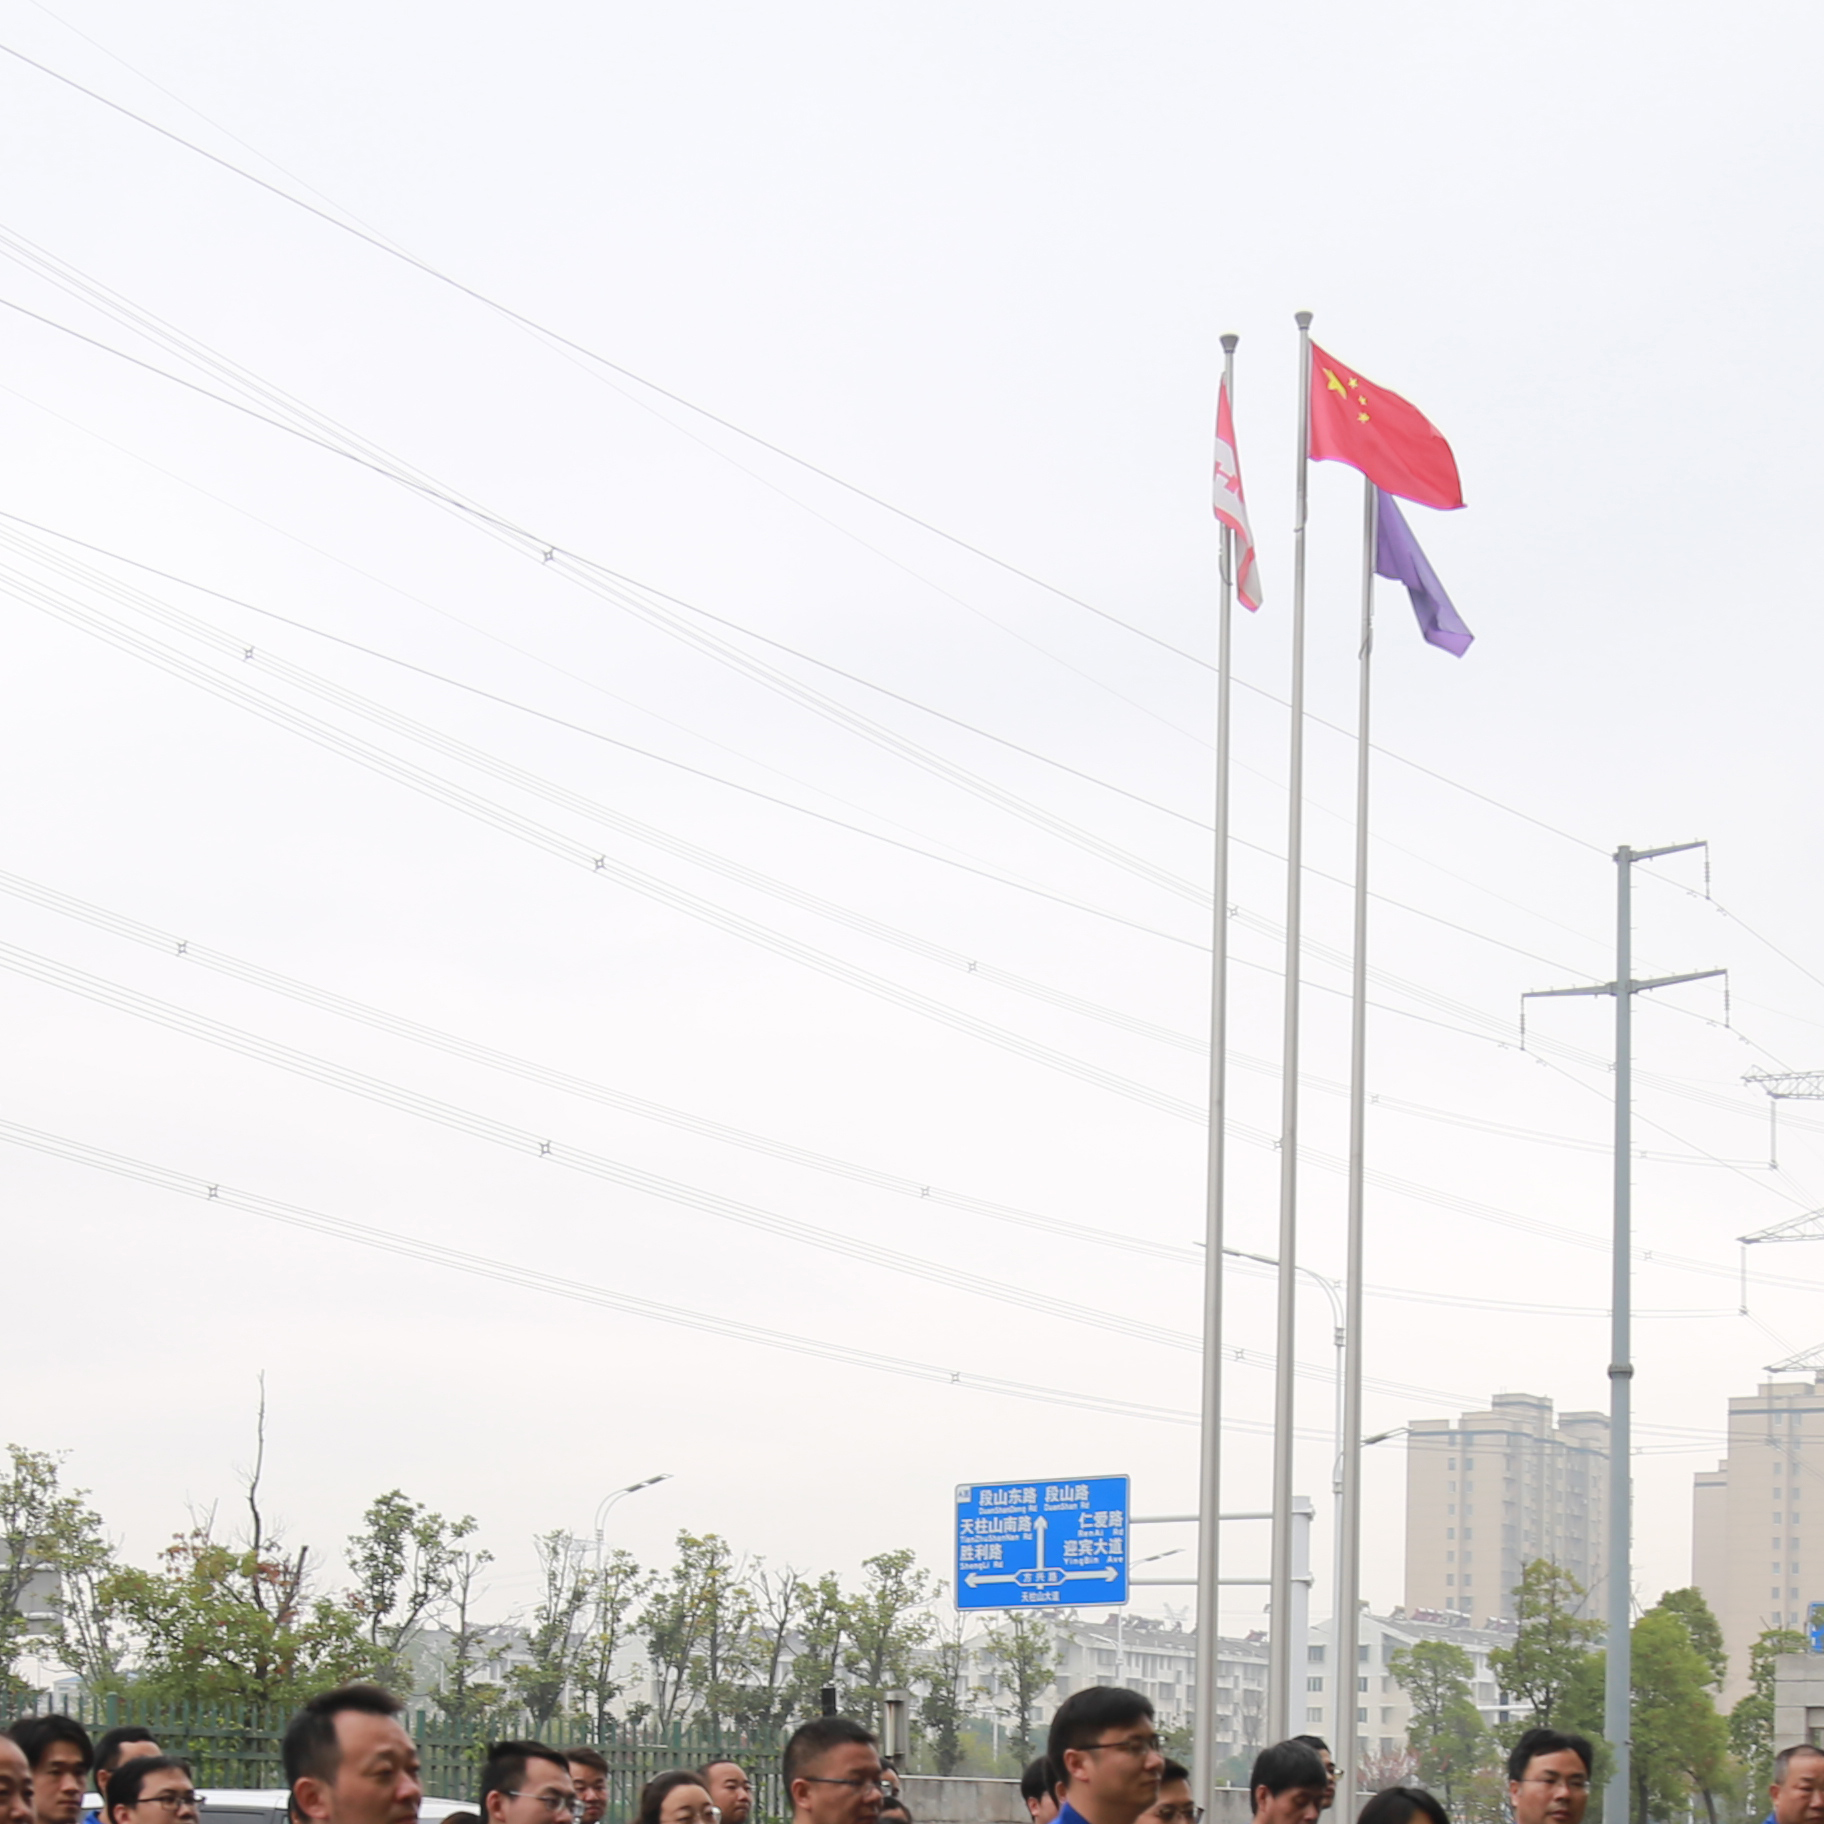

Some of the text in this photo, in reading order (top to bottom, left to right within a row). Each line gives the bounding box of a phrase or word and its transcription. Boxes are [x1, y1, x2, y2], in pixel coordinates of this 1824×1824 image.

[979, 1487, 1037, 1506] 段山东路
[1044, 1484, 1089, 1502] 段山路
[1028, 1504, 1037, 1512] Rd
[1080, 1501, 1090, 1509] Rd
[960, 1515, 1032, 1534] 天柱山南路
[1078, 1510, 1123, 1528] 仁爱路
[960, 1543, 1003, 1560] 胜利路
[1063, 1537, 1123, 1556] 迎宾大道
[993, 1560, 1004, 1568] Rd
[1106, 1555, 1123, 1563] Ave
